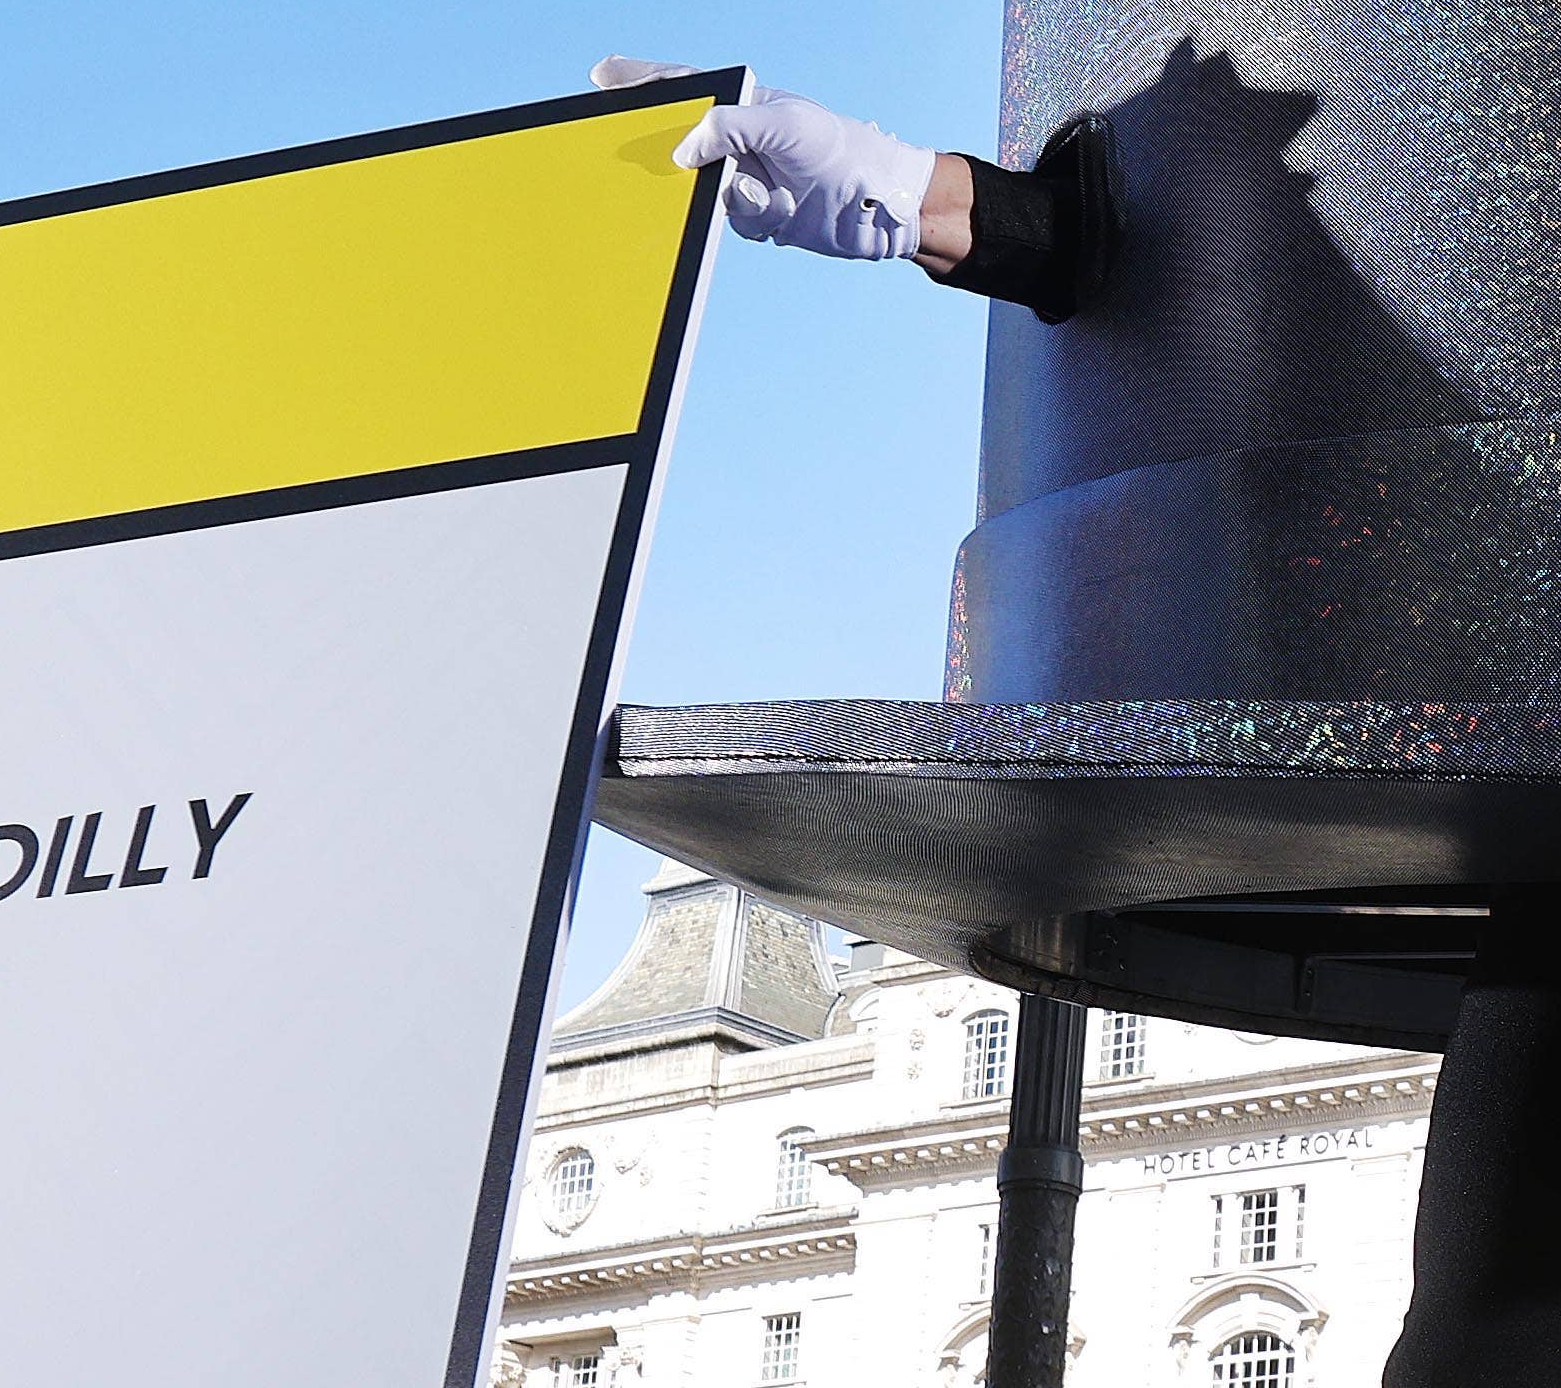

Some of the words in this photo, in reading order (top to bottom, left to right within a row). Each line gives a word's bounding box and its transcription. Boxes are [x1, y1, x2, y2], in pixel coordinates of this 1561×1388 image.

[1144, 1147, 1216, 1176] HOTEL
[1227, 1134, 1288, 1166] CAFÉ
[1300, 1128, 1374, 1156] ROYAL
